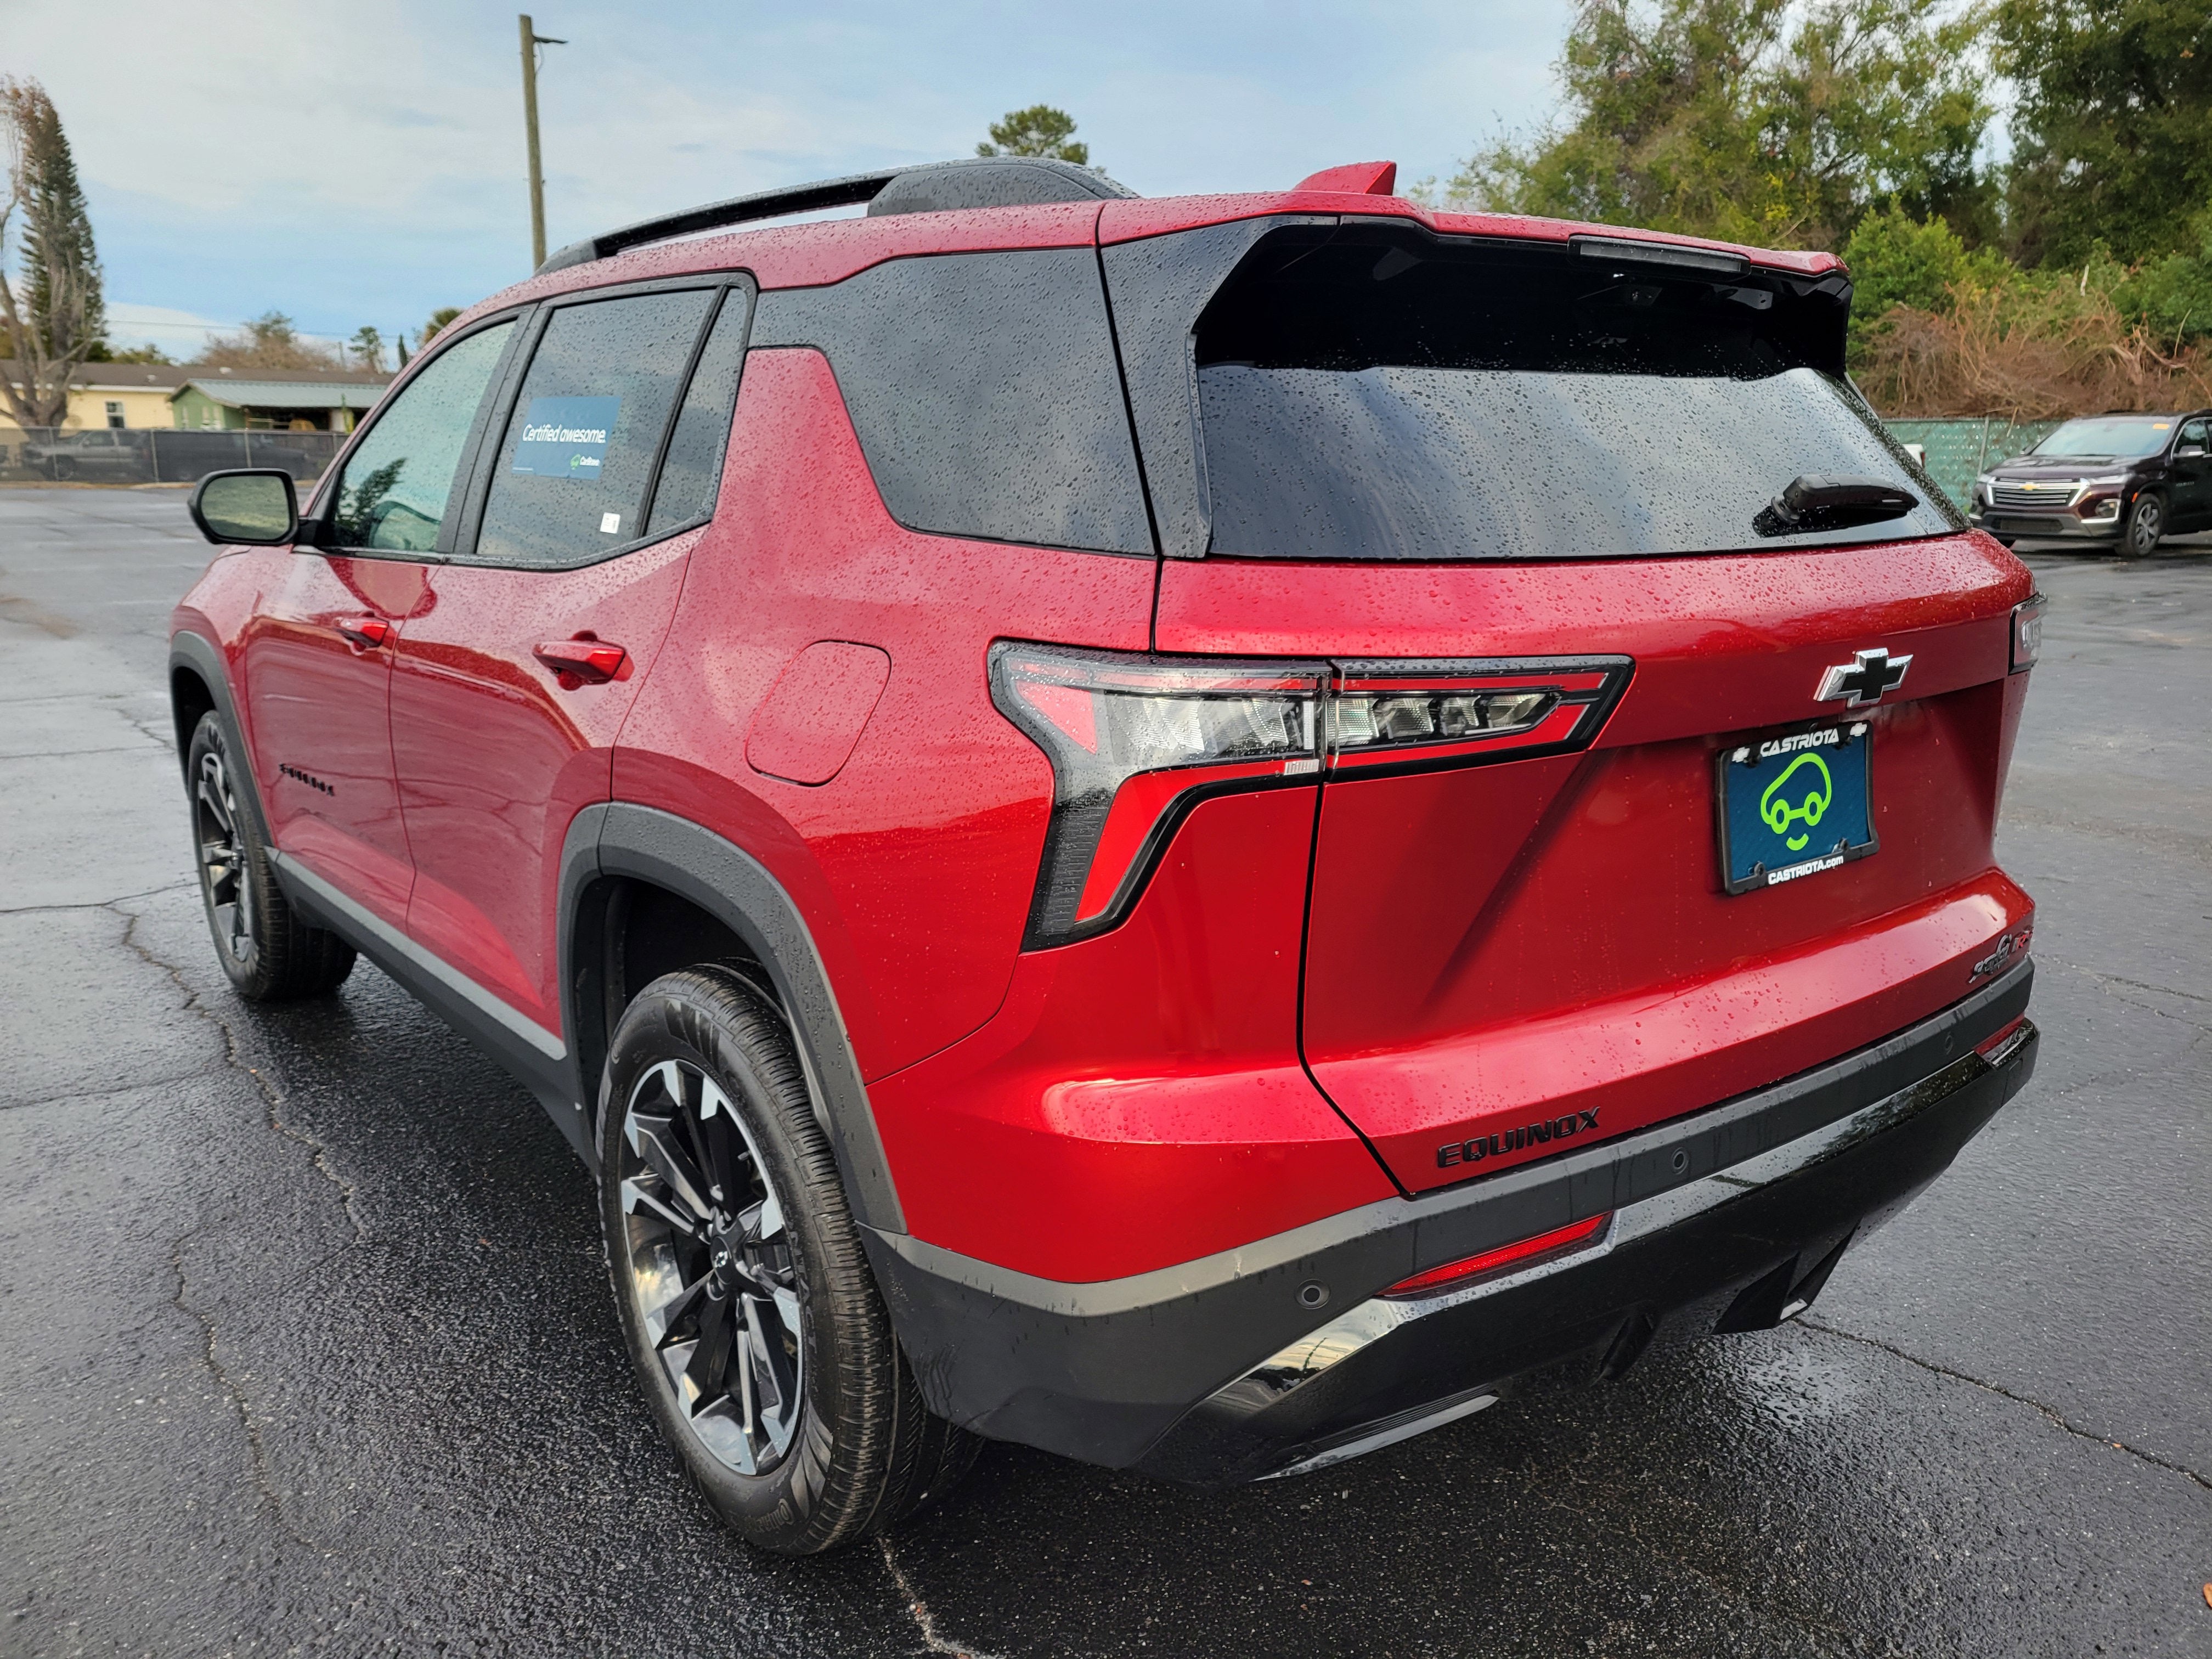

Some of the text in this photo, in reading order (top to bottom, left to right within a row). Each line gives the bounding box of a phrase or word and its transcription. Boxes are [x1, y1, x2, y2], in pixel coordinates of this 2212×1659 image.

[522, 424, 606, 444] Certified awesome.
[1760, 729, 1839, 758] CASTRIOTA
[1768, 855, 1844, 885] CASTRIOTA.com
[1437, 1105, 1601, 1169] EQUINOX
